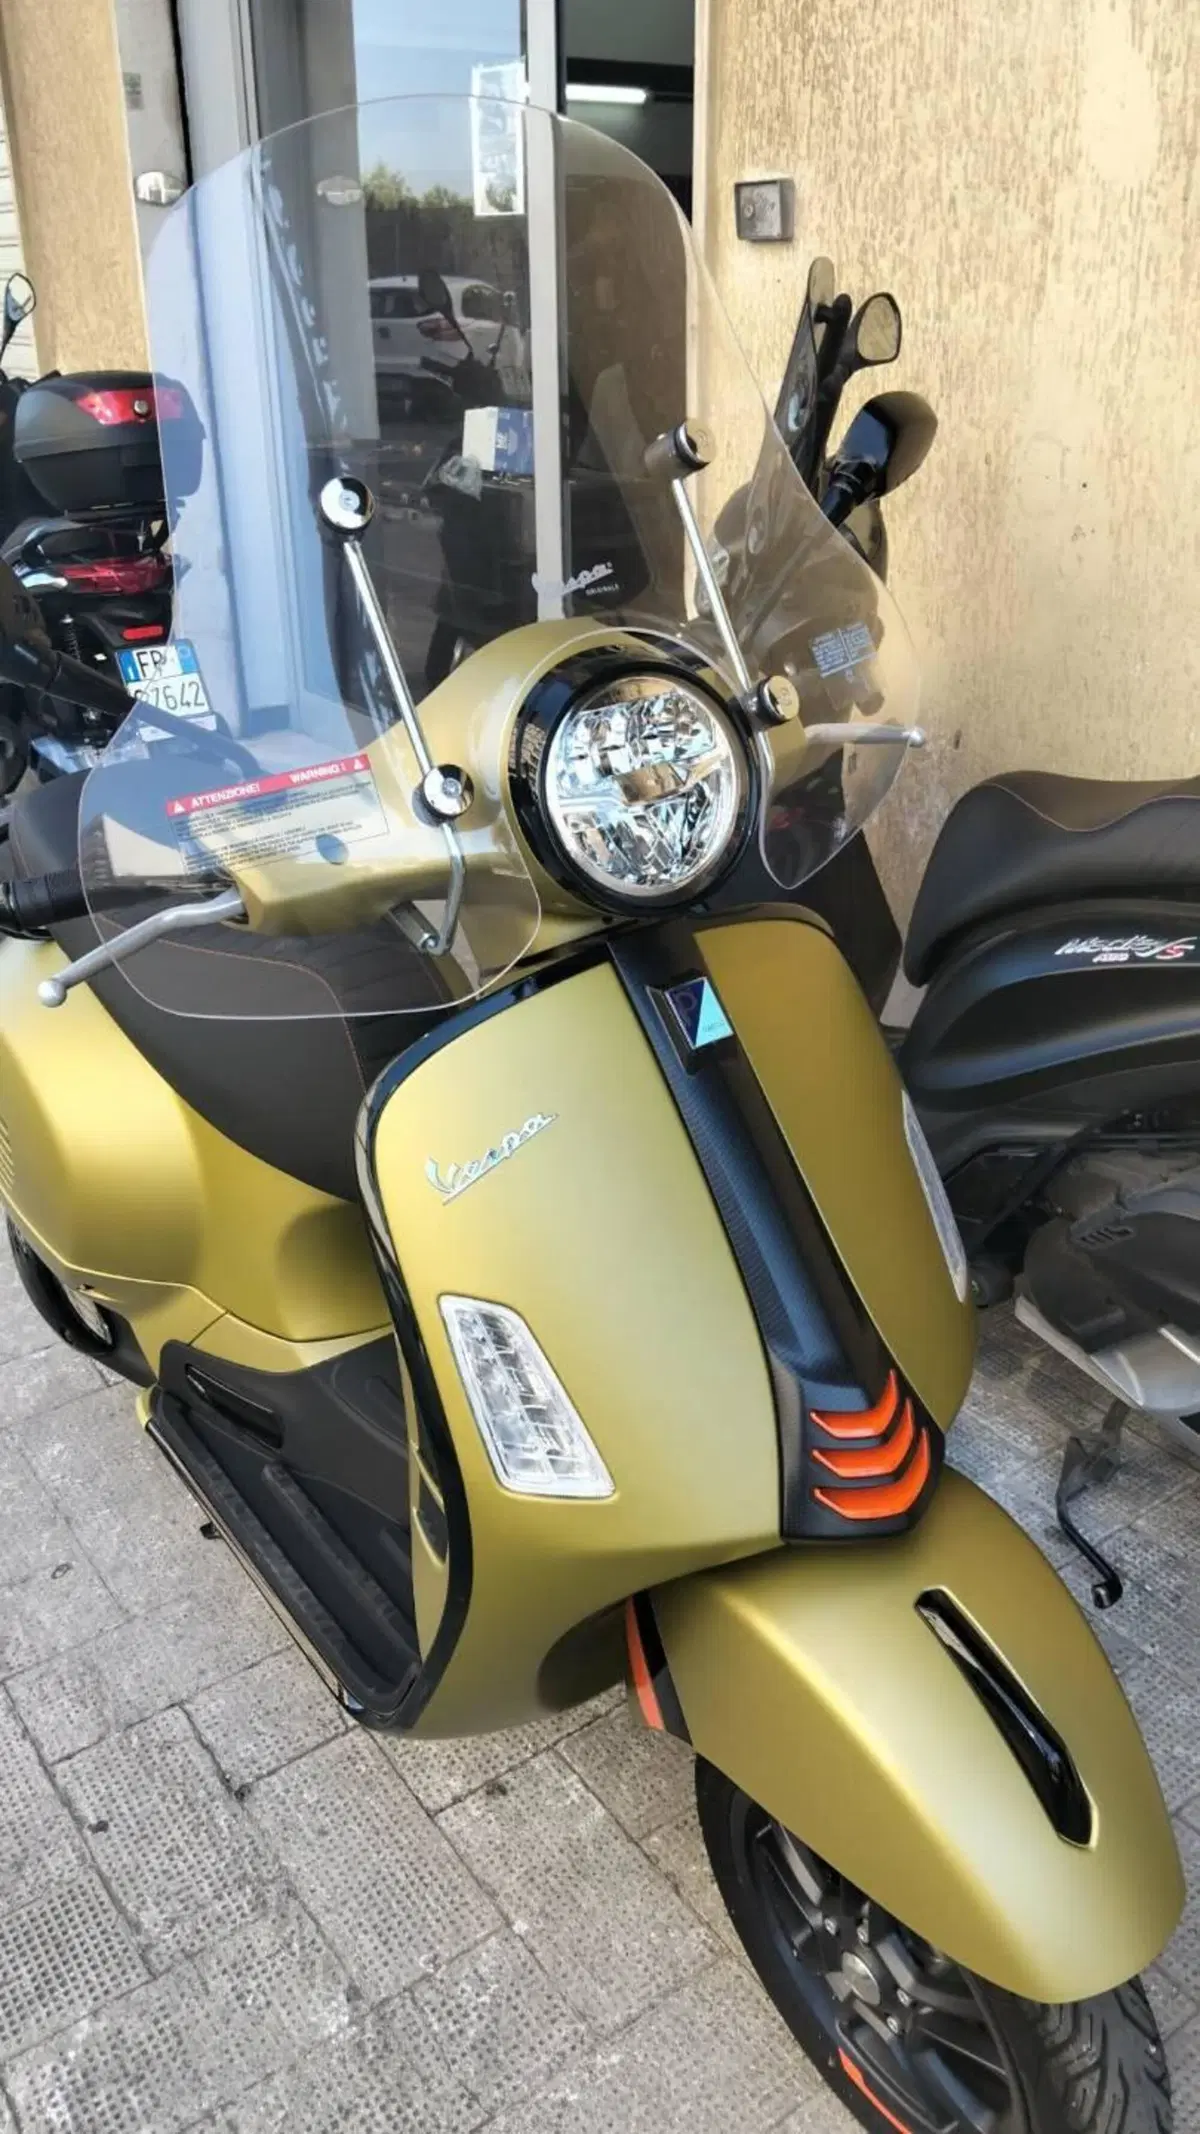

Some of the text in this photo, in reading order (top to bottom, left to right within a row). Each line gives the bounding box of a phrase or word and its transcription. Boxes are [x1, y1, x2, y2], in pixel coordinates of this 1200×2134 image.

[532, 562, 613, 599] Vspa
[190, 782, 260, 809] ATTENZIONE!
[288, 763, 340, 784] WARNING
[424, 1112, 560, 1207] Vespa
